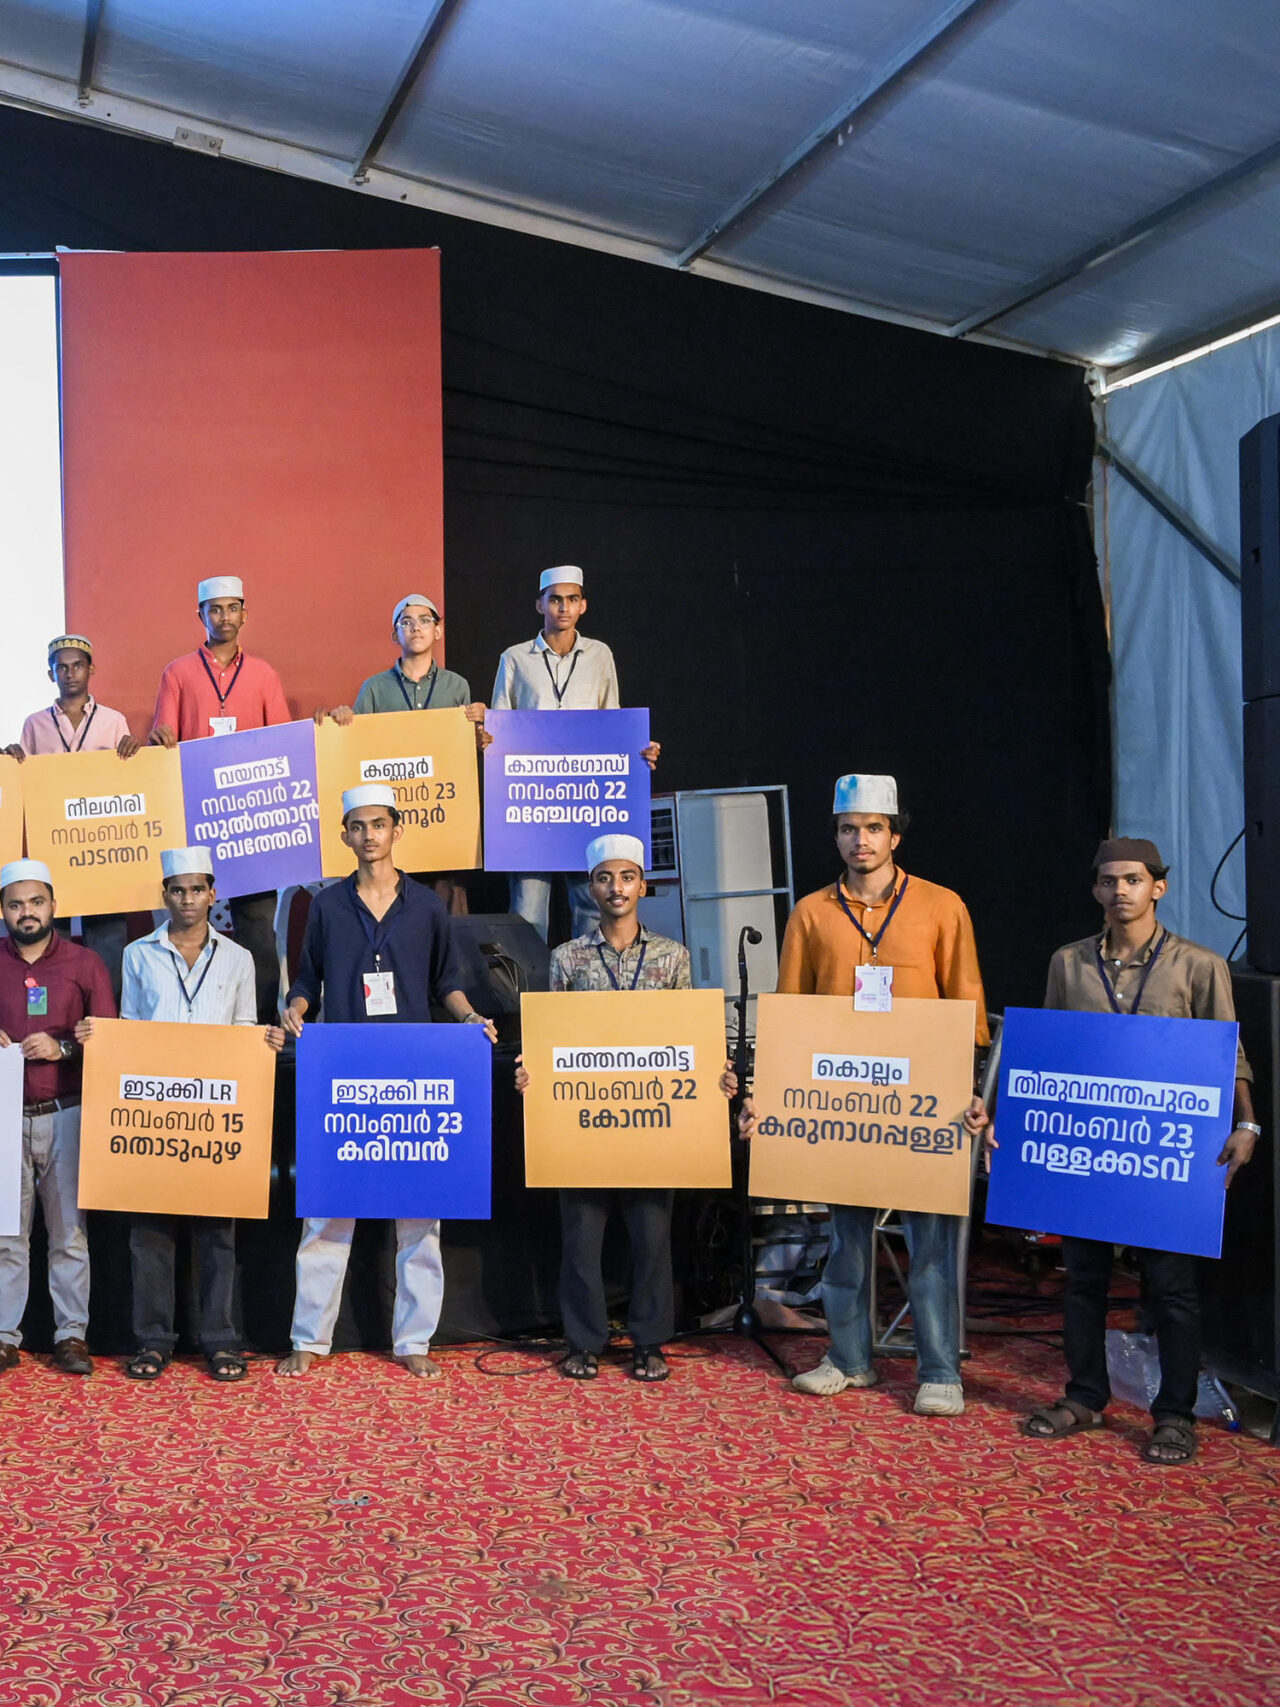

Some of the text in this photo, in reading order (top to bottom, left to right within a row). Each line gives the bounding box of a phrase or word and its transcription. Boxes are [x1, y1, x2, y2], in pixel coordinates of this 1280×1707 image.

[220, 756, 284, 785] വയനാട്
[364, 758, 429, 781] കണ്ണൂർ
[508, 754, 627, 773] കാസർഗോഡ്
[201, 780, 312, 816] നവംബർ 22
[435, 782, 456, 800] 23
[508, 779, 626, 800] നവംബർ 22
[68, 795, 141, 817] നീലഗിരി
[52, 821, 162, 845] നവംബർ 15
[216, 822, 313, 860] ബത്തേരി
[69, 846, 148, 866] പാടന്തറ
[556, 1047, 690, 1071] പത്തനംതിട്ട
[817, 1058, 903, 1087] കൊല്ലം
[123, 1078, 231, 1102] ഇടുക്കി LR
[336, 1079, 449, 1104] ഇടുക്കി HR
[553, 1076, 697, 1101] നവംബർ 22
[784, 1085, 938, 1118] നവംബർ 22
[1014, 1071, 1209, 1112] തിരുവനന്തപുരം
[110, 1106, 243, 1133] നവംബർ 15
[324, 1109, 462, 1135] നവംബർ 23
[579, 1102, 671, 1129] കോന്നി
[1025, 1108, 1193, 1148] നവംബർ 23
[337, 1134, 449, 1162] കരിമ്പൻ
[758, 1116, 962, 1155] കരുനാഗപ്പള്ളി
[110, 1134, 241, 1165] തൊടുപുഴ
[1021, 1140, 1195, 1183] വള്ളക്കടവ്
